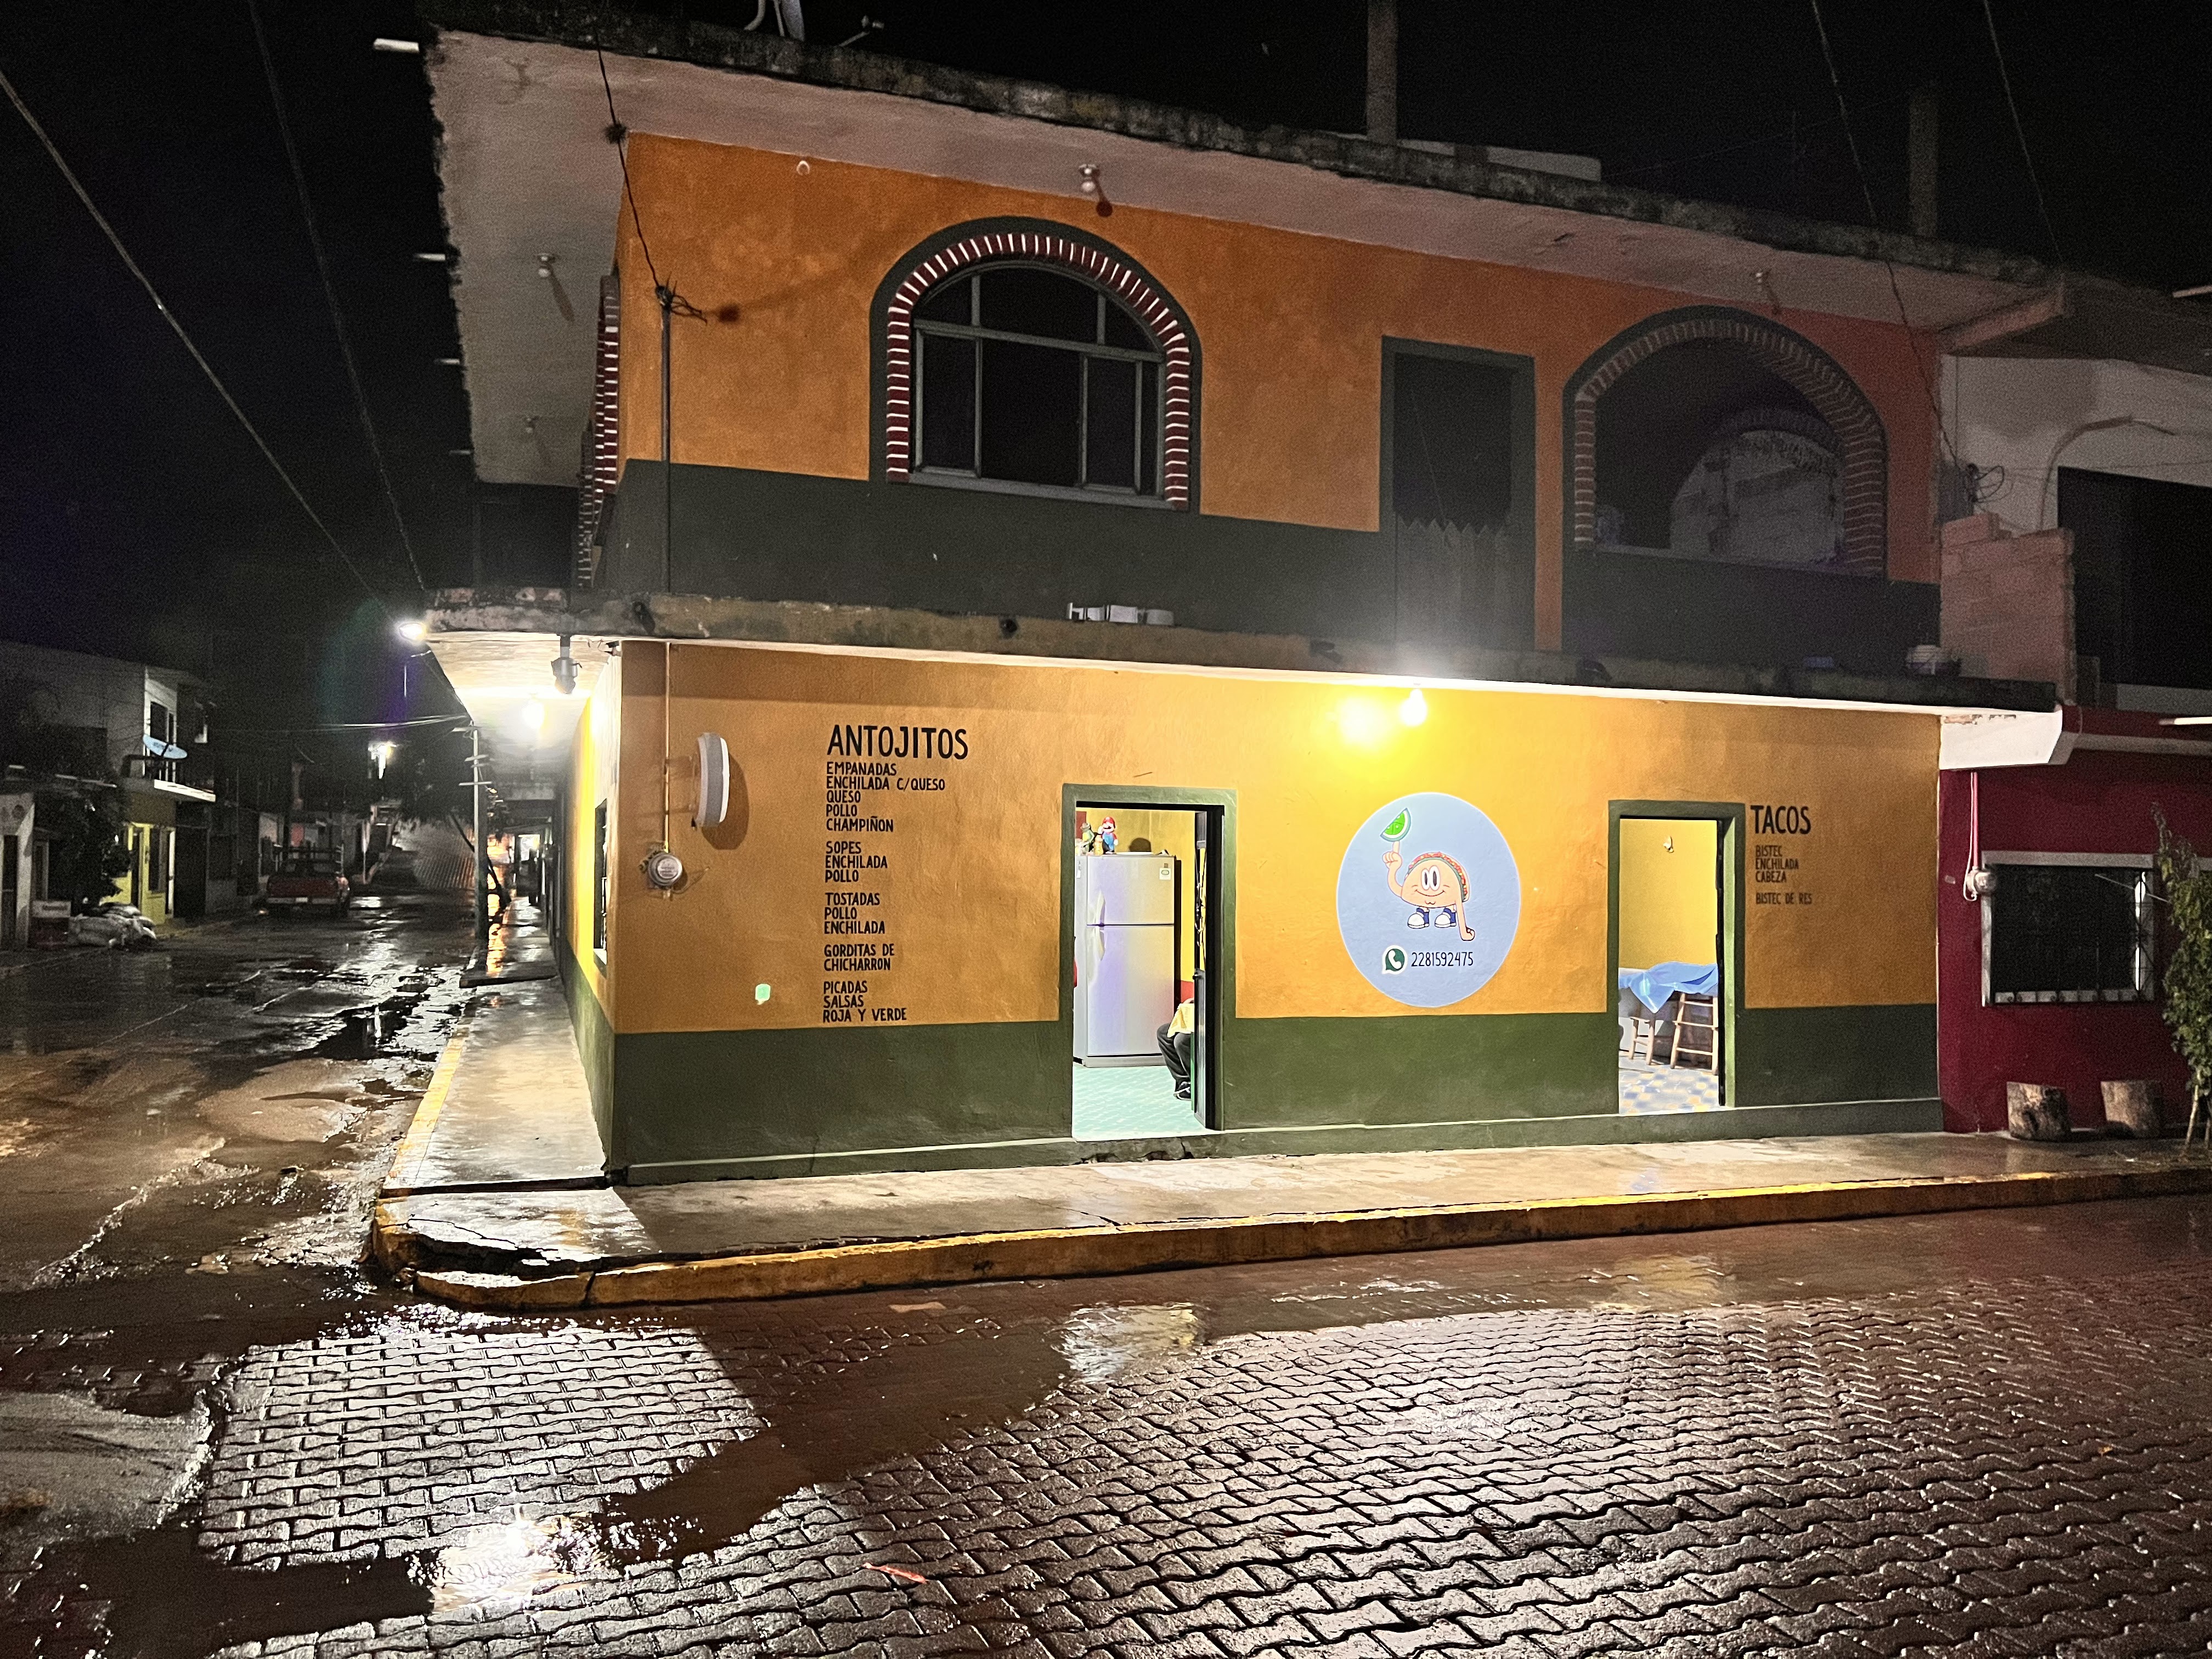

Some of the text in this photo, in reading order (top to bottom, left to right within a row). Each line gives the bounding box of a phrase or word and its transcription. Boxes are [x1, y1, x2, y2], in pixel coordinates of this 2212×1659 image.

[827, 724, 968, 759] ANTOJITOS
[826, 761, 897, 776] EMPANADAS
[826, 776, 945, 792] ENCHILADA C/QUESO
[826, 790, 861, 803] QUESO
[826, 804, 857, 817] POLLO
[826, 816, 894, 832] CHAMPIÑON
[1750, 805, 1812, 834] TACOS
[826, 841, 861, 854] SOPES
[1756, 845, 1783, 857] BISTEC
[825, 855, 888, 868] ENCHILADA
[1756, 857, 1799, 871] ENCHILADA
[825, 870, 859, 883] POLLO
[1756, 871, 1787, 883] CABEZA
[825, 892, 880, 906] TOSTADAS
[1756, 892, 1813, 905] BISTEC DE RES
[824, 907, 857, 920] POLLO
[824, 921, 885, 934] ENCHILADA
[823, 944, 895, 957] GORDITAS DE
[823, 958, 891, 971] CHICHARRON
[1411, 951, 1474, 967] 2281592475
[823, 980, 868, 994] PICADAS
[823, 995, 864, 1008] SALSAS
[823, 1007, 907, 1023] ROJA Y VERDE
